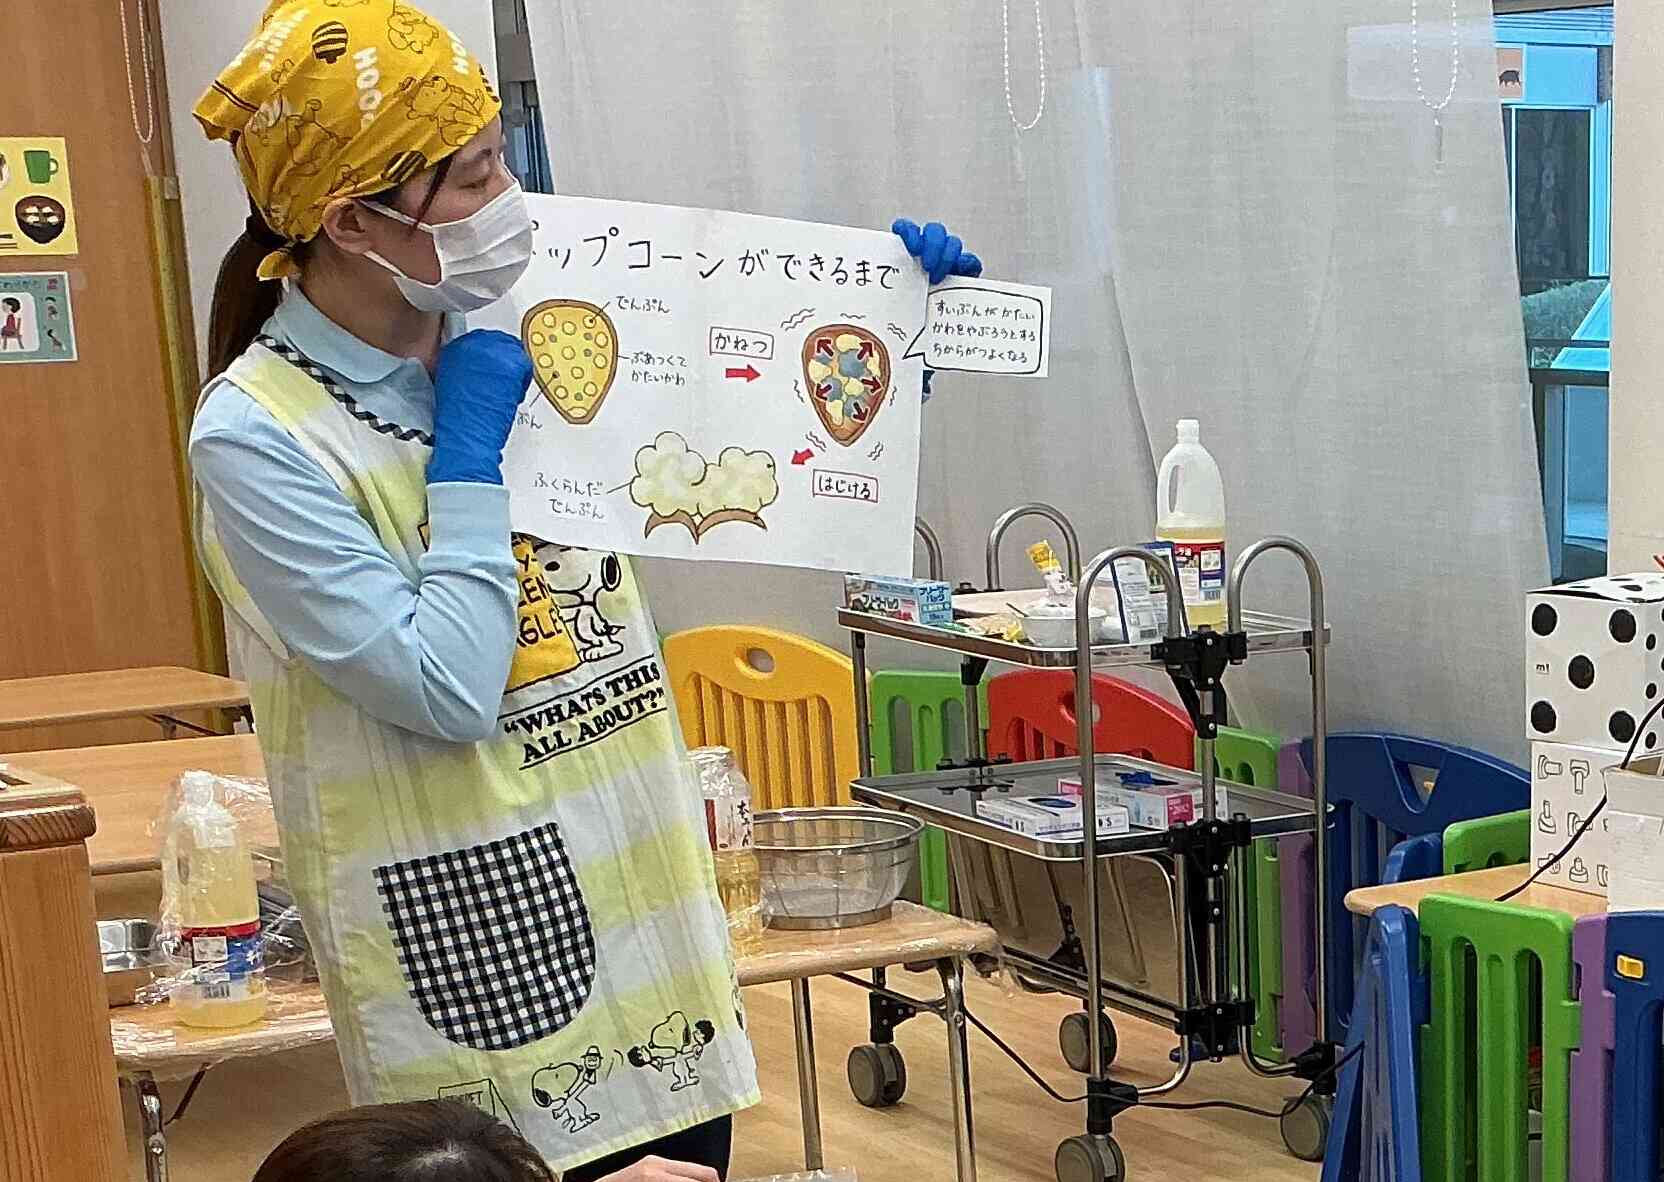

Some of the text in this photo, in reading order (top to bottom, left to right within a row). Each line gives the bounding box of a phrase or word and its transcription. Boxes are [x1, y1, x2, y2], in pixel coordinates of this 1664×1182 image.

[714, 332, 768, 354] かねつ
[534, 471, 604, 497] ふくらんだ
[818, 475, 872, 500] はじける
[549, 498, 604, 519] でんぷん
[517, 607, 562, 647] GLE
[605, 661, 661, 698] THIS
[523, 730, 573, 763] ALL
